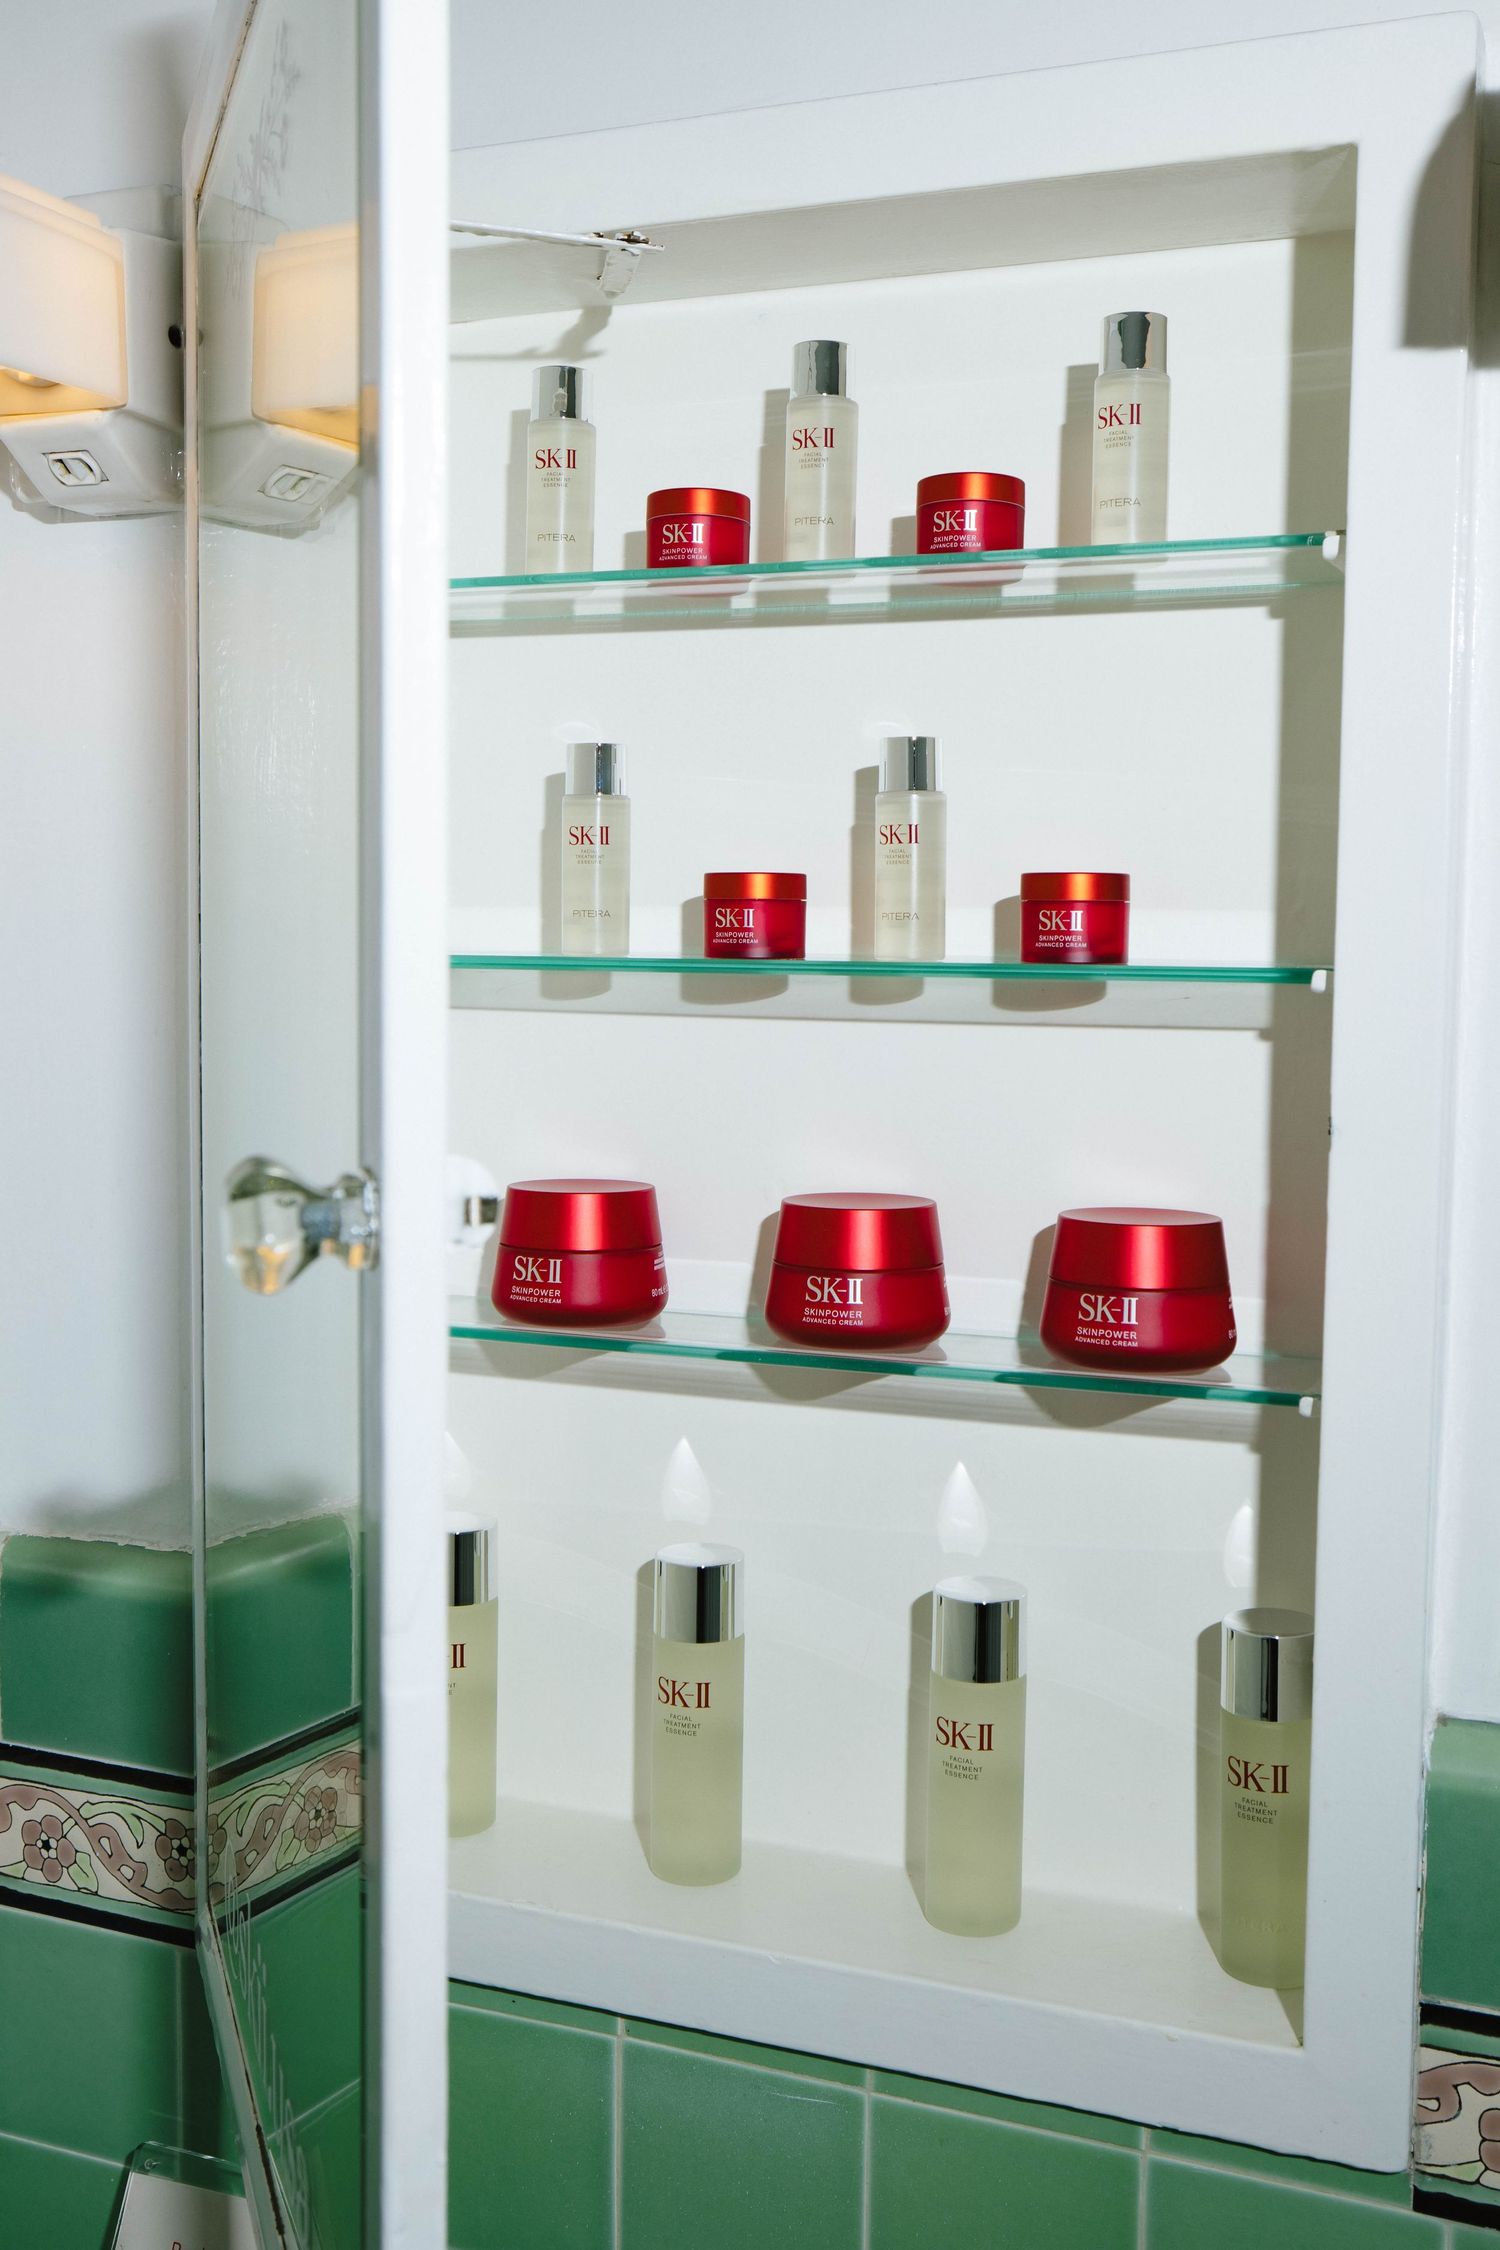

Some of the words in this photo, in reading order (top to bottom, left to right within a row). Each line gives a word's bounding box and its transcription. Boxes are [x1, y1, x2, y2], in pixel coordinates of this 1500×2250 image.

[1097, 403, 1142, 430] SK-II
[792, 427, 835, 451] SK-II
[535, 448, 577, 470] SK-II
[1100, 497, 1141, 509] PITERA
[794, 516, 834, 526] PITERA
[933, 509, 978, 532] SK-II
[537, 533, 576, 542] PITERA
[662, 523, 704, 545] SK-II
[934, 535, 976, 543] SKINPOWER
[662, 547, 703, 555] SKINPOWER
[930, 542, 958, 550] ADVANCED
[569, 826, 610, 845] SK-II
[879, 824, 920, 845] SK-II
[572, 909, 611, 918] PITERA
[715, 907, 755, 928] SK-II
[881, 912, 920, 920] PITERA
[1039, 909, 1084, 931] SK-II
[513, 1255, 562, 1284] SK-II
[511, 1285, 561, 1297] SKINPOWER
[805, 1275, 863, 1305] SK-II
[509, 1295, 538, 1303] ADVANCED
[804, 1307, 862, 1319] SKINPOWER
[1078, 1293, 1139, 1325] SK-II
[802, 1316, 837, 1325] ADVANCED
[838, 1318, 864, 1326] CREAM
[1076, 1326, 1137, 1340] SKINPOWER
[1074, 1336, 1110, 1346] ADVANCED
[1112, 1339, 1138, 1347] CREAM
[658, 1676, 711, 1708] SK-II
[669, 1713, 692, 1721] FACIAL
[663, 1719, 701, 1729] TREATMENT
[665, 1727, 697, 1736] ESSENCE
[936, 1716, 994, 1751] SK-II
[949, 1755, 974, 1765] FACIAL
[942, 1760, 983, 1773] TREATMENT
[944, 1769, 979, 1780] ESSENCE
[1227, 1755, 1290, 1793] SK-II
[1241, 1797, 1268, 1807] FACIAL
[1234, 1801, 1278, 1816] TREATMENT
[1237, 1812, 1274, 1824] ESSENCE
